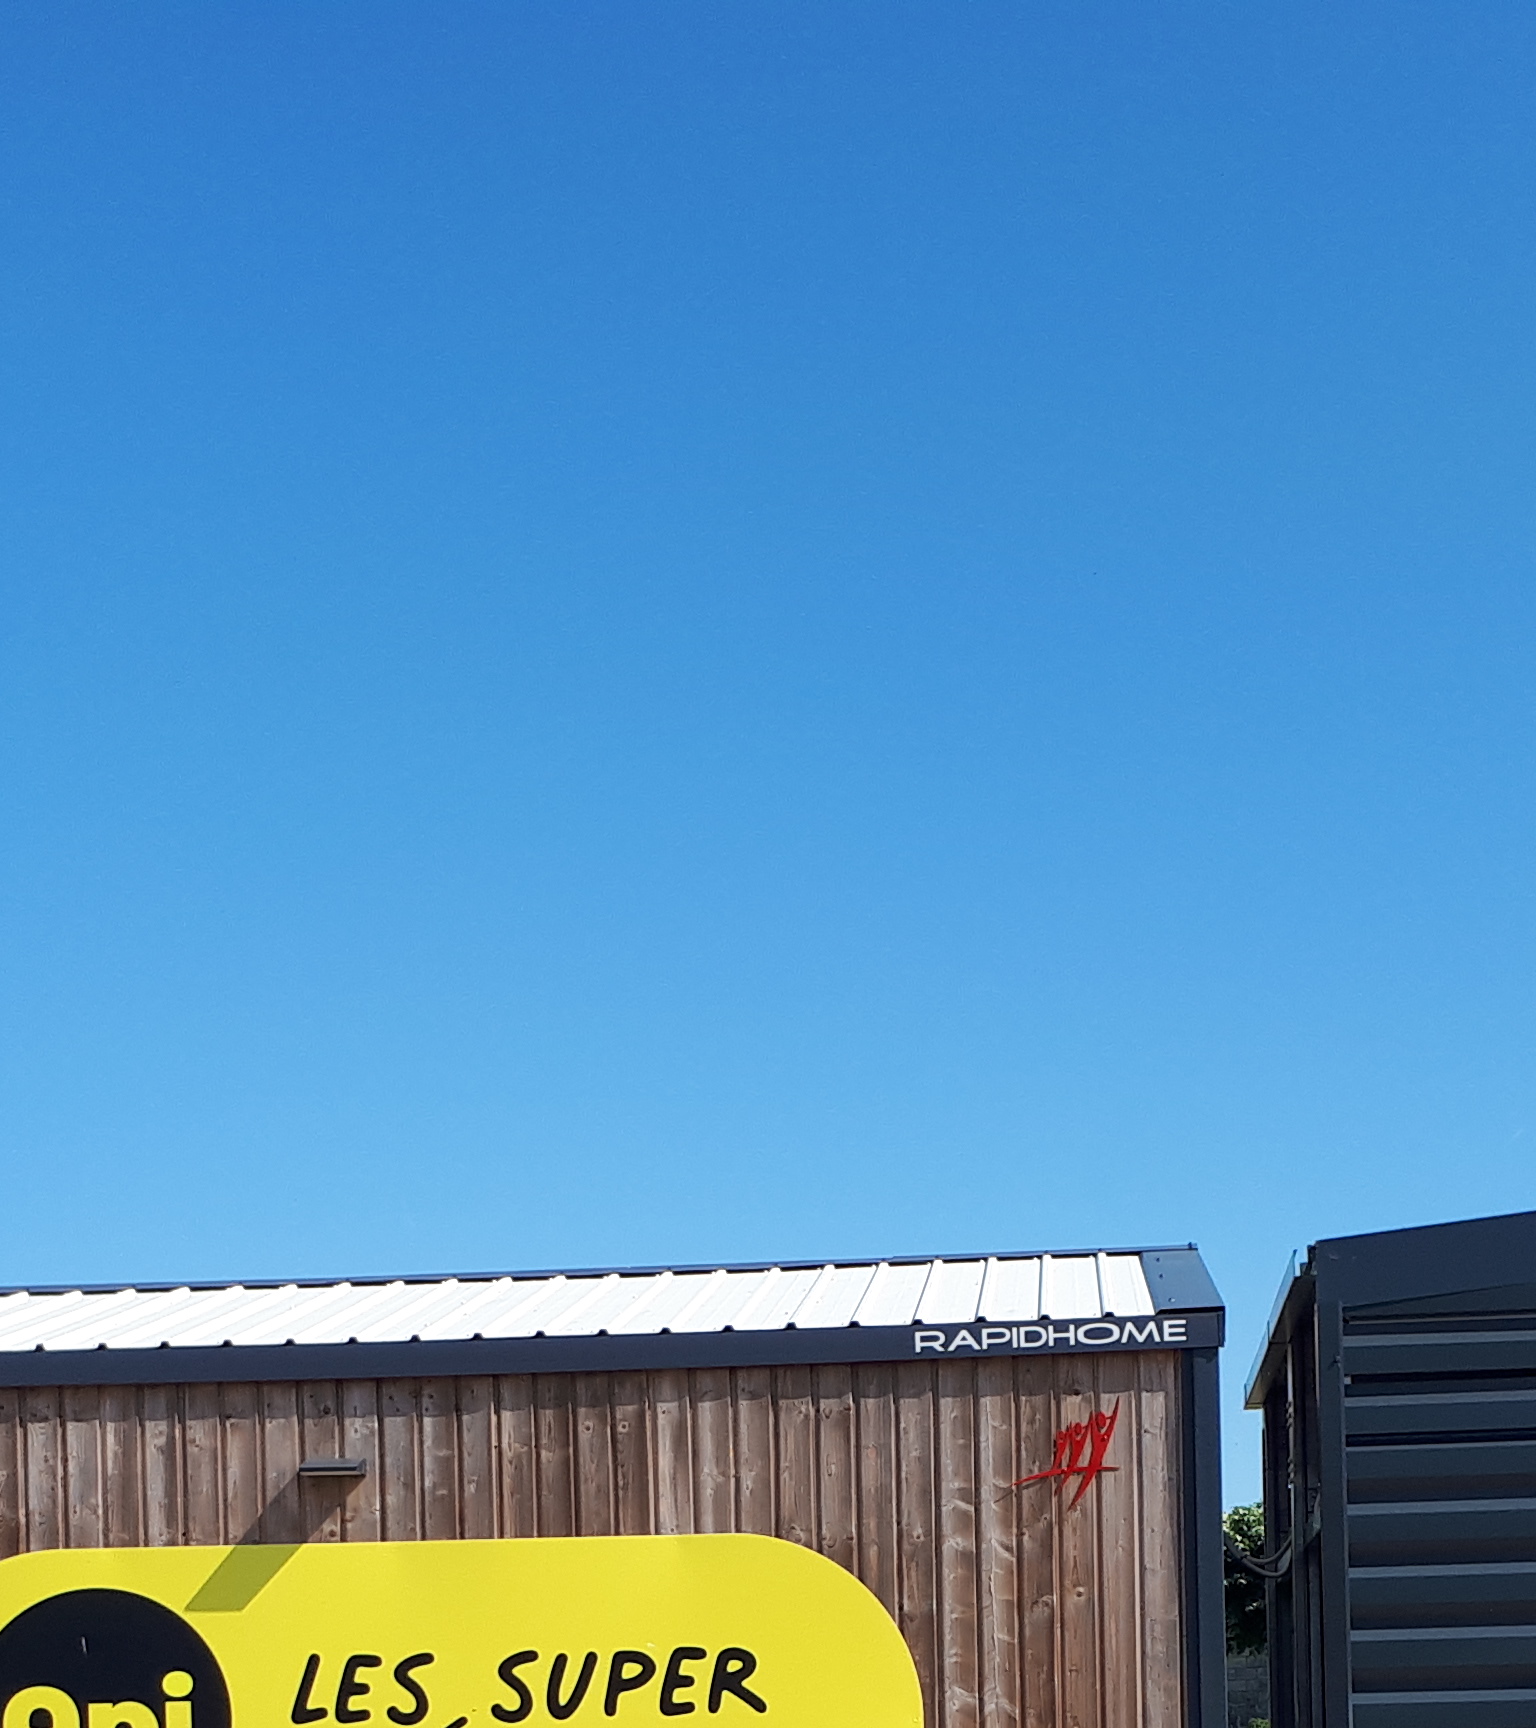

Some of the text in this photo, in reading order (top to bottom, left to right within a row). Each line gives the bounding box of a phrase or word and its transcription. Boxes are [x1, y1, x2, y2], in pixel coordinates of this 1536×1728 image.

[914, 1320, 1188, 1353] RAPIDHOME
[291, 1646, 768, 1726] LES SUPER
